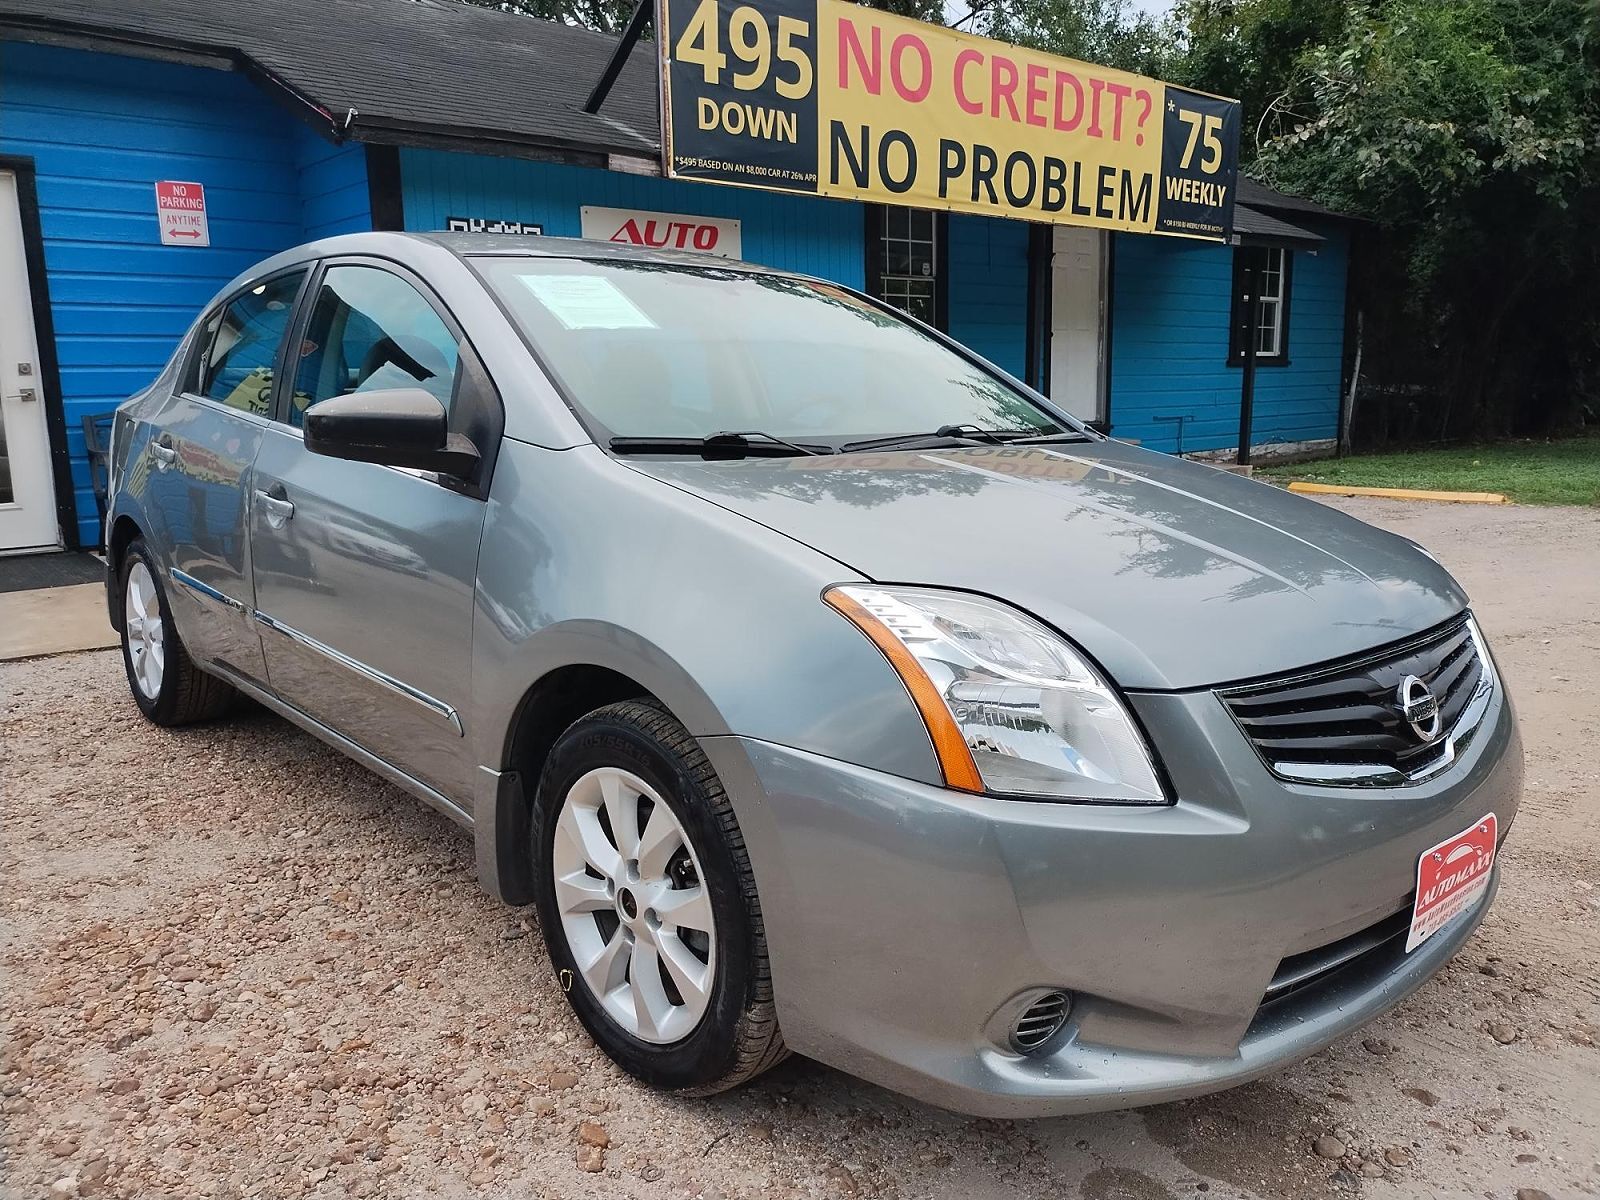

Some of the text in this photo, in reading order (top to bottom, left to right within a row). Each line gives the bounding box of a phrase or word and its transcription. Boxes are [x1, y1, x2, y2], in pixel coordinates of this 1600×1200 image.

[676, 0, 813, 100] 495
[838, 17, 1152, 147] NO CREDIT?
[698, 97, 797, 144] DOWN
[698, 159, 721, 170] BASED
[722, 162, 733, 172] ON
[734, 164, 745, 173] AN
[746, 165, 767, 176] $8,000
[768, 168, 781, 178] CAR
[782, 170, 790, 179] AT
[804, 173, 817, 182] APR
[830, 119, 1153, 223] NO PROBLEM
[160, 196, 203, 209] PARKING
[173, 185, 187, 196] NO
[1166, 176, 1226, 208] WEEKLY
[166, 215, 201, 226] ANYTIME
[609, 218, 719, 250] AUTO
